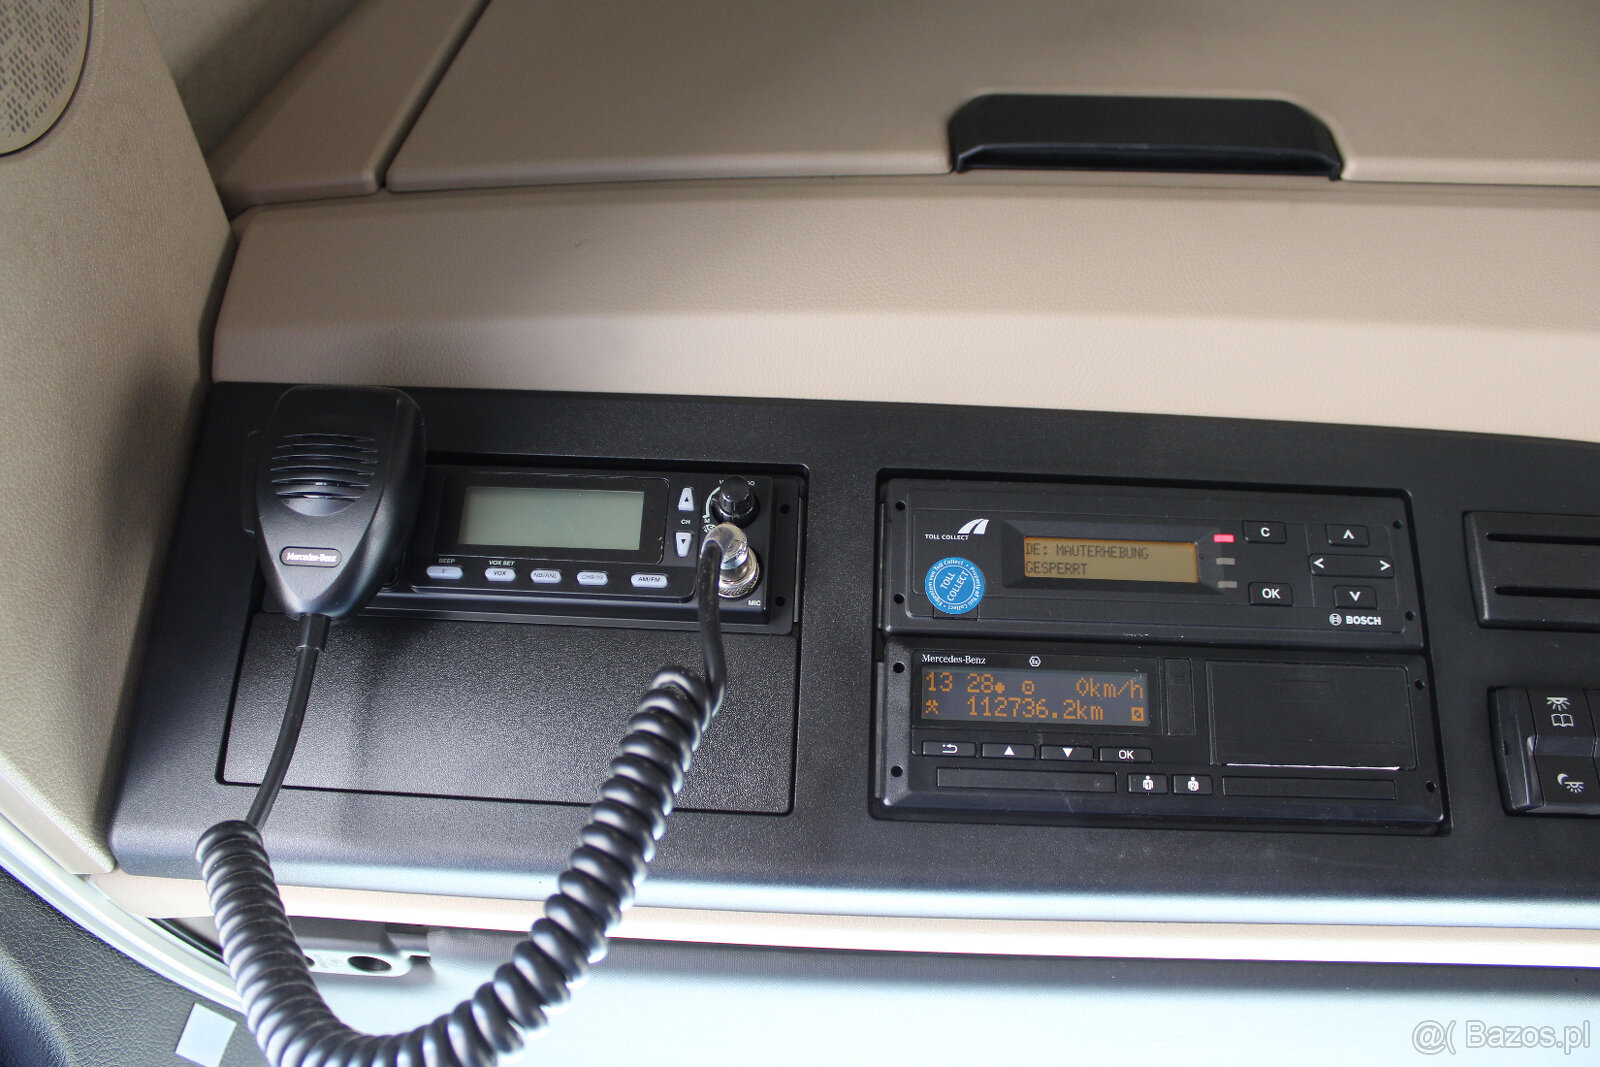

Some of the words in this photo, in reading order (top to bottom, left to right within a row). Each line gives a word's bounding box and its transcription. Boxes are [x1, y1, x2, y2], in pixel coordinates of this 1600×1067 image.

[1260, 527, 1270, 537] C
[1025, 542, 1047, 555] DE:
[1056, 544, 1149, 559] MAUTERHEBUNG
[1025, 561, 1088, 575] GESPERRT
[940, 572, 956, 589] TOLL
[946, 570, 969, 602] COLLECT
[1262, 588, 1281, 599] OK
[1345, 615, 1382, 626] BOSCH
[921, 654, 986, 665] Mercedes-Benz
[926, 671, 953, 692] 13
[967, 673, 994, 693] 28
[1076, 677, 1144, 699] 0km/h
[967, 695, 1104, 721] 112736.2km
[1118, 749, 1134, 760] OK
